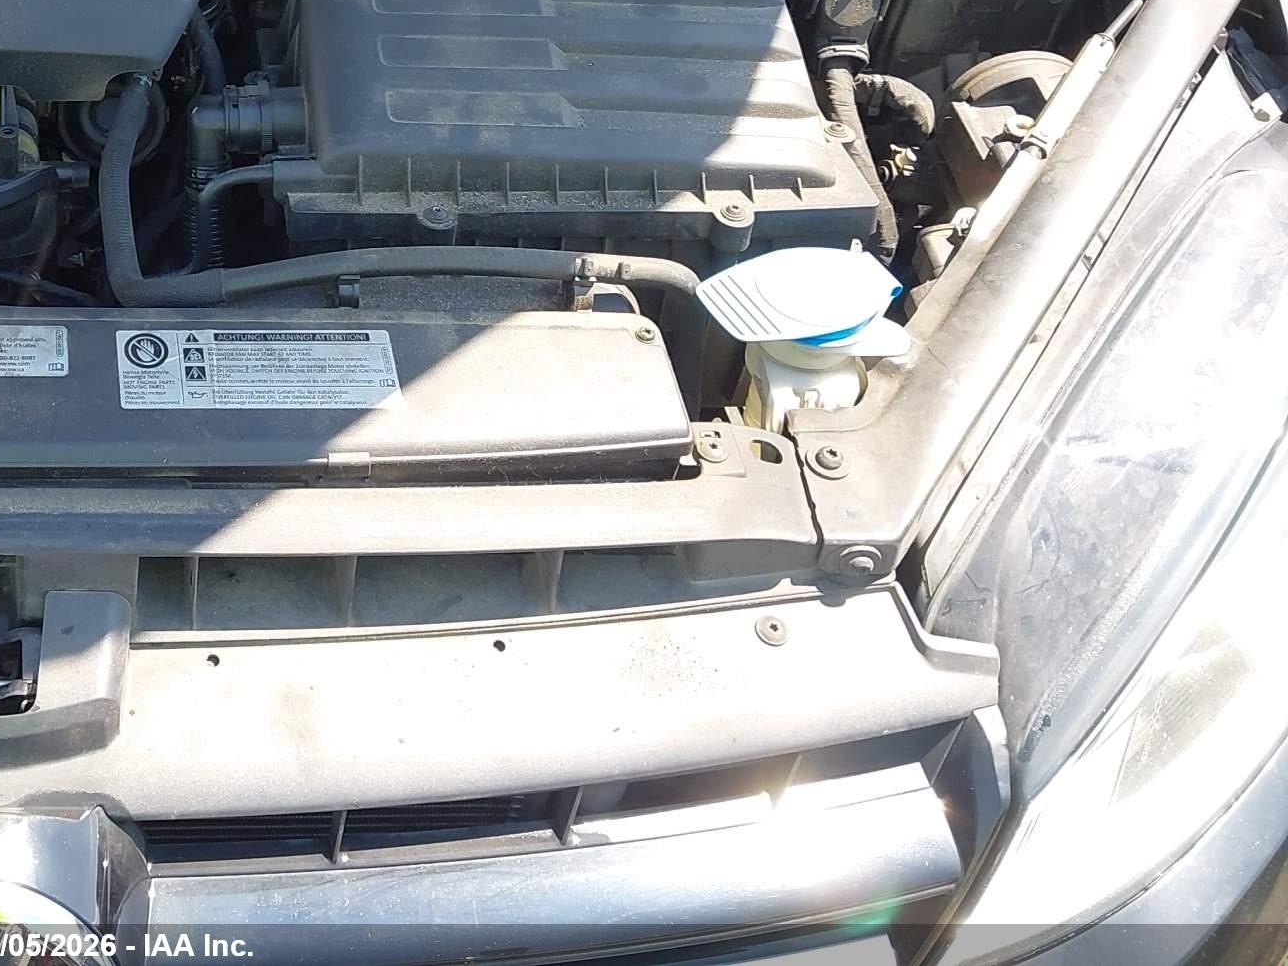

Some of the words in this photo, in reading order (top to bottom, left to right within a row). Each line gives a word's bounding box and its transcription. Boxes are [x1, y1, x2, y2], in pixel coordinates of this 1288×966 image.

[217, 333, 264, 341] ACHTUNG!
[266, 333, 312, 341] WARNING!
[315, 333, 367, 341] ATTENTION!
